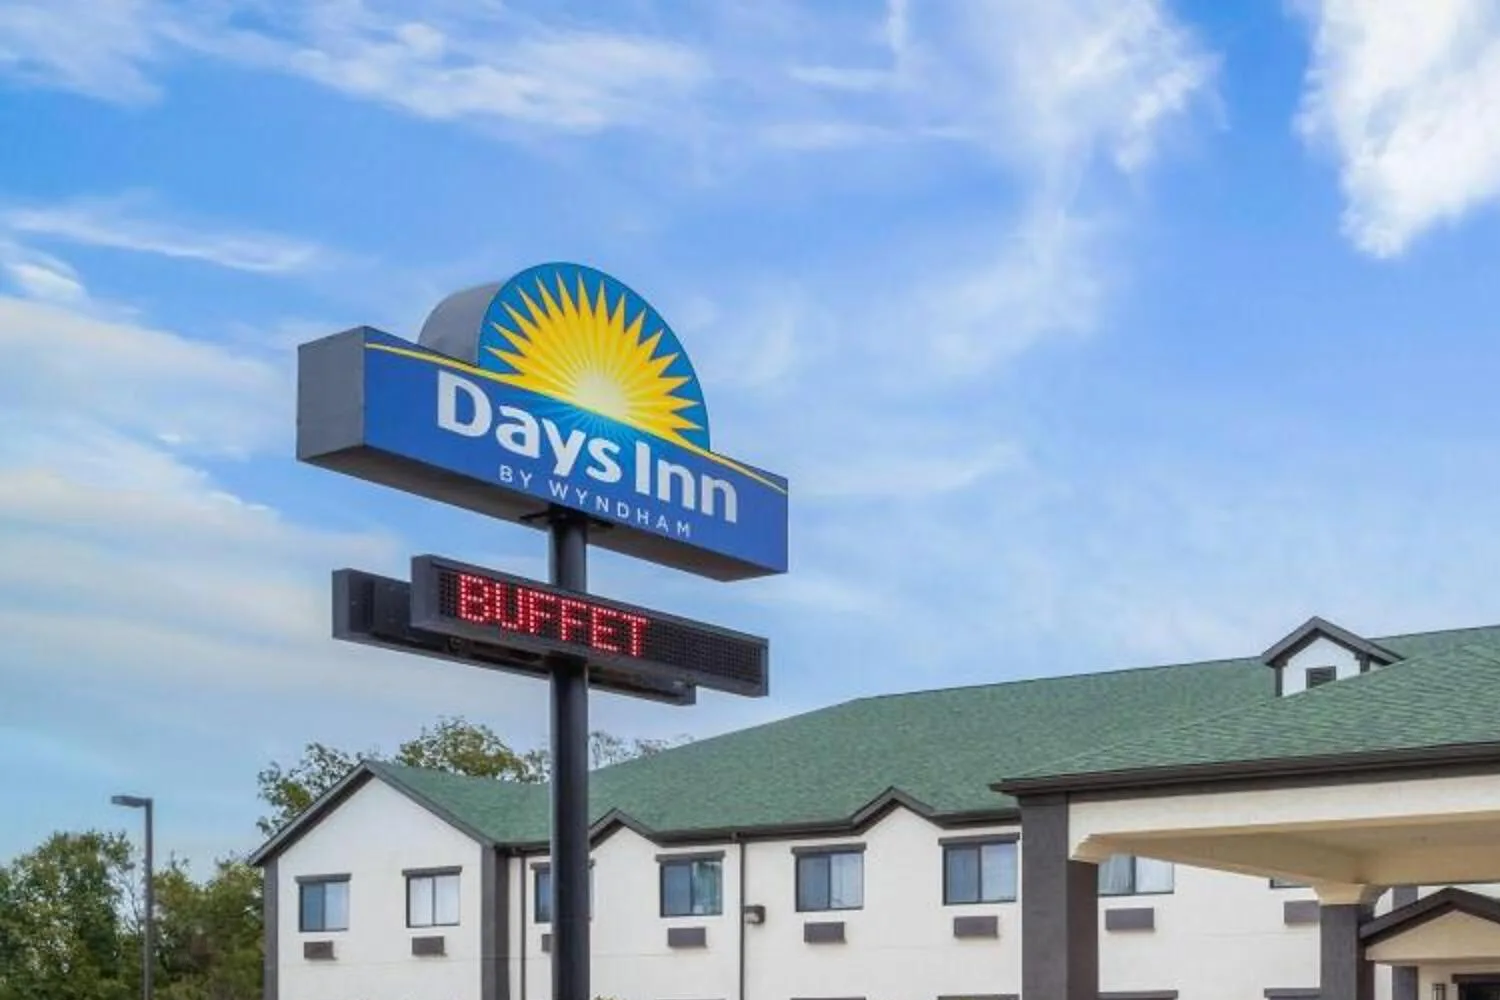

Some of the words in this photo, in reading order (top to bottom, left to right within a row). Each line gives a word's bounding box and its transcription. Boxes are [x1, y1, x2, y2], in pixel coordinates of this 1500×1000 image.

[437, 370, 622, 482] Days
[635, 441, 738, 523] Inn
[500, 465, 534, 489] BY
[548, 478, 692, 538] WYNDHAM
[459, 573, 647, 658] BUFFET
